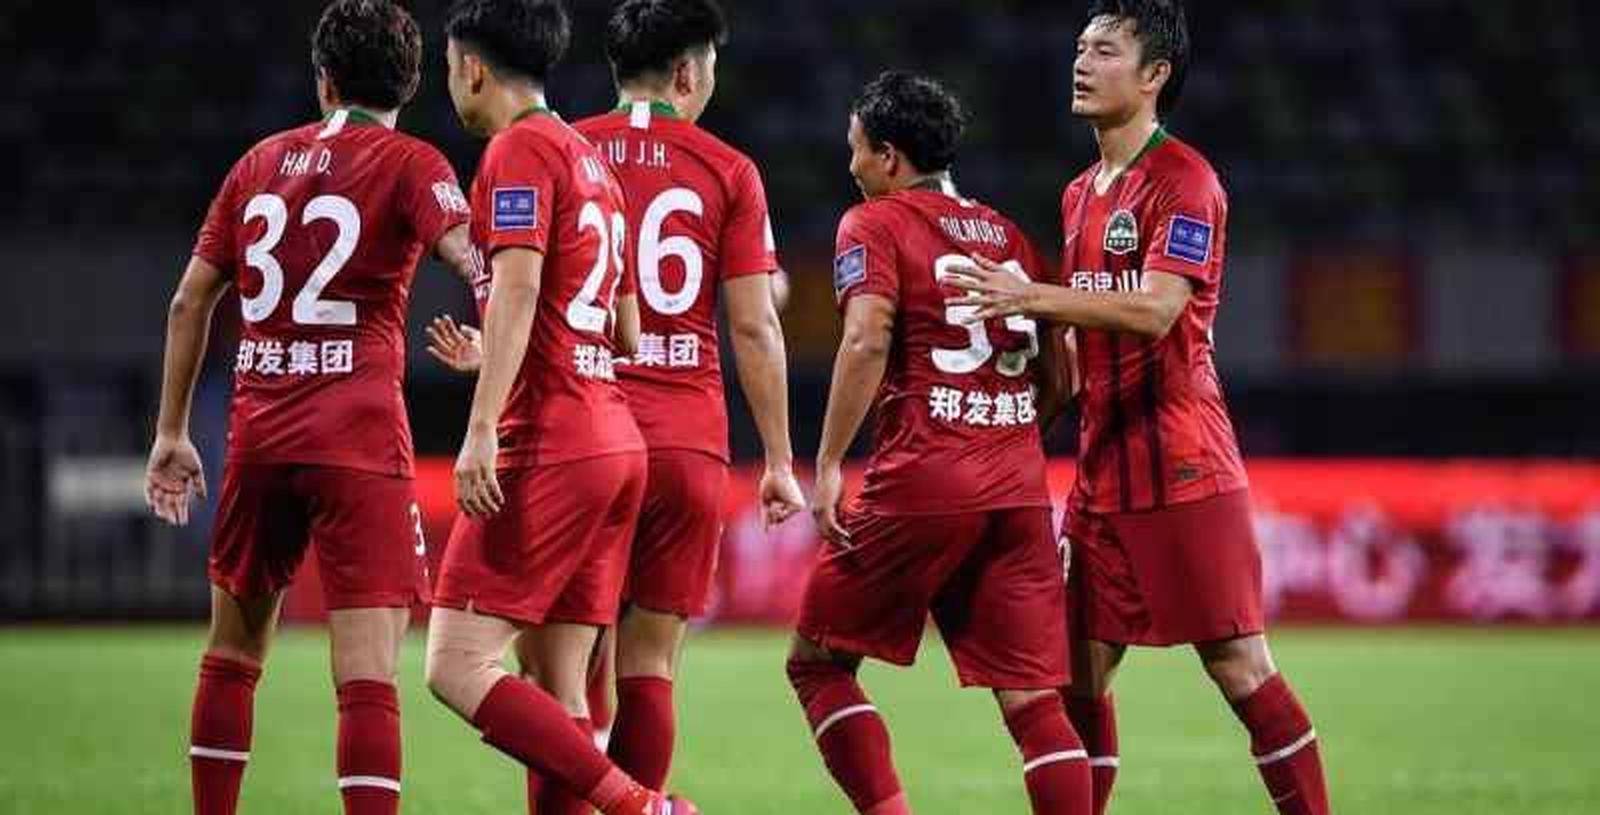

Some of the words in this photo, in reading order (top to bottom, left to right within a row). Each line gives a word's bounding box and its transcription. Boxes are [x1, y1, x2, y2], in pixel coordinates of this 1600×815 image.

[635, 140, 671, 168] J.H.
[240, 192, 361, 325] 32
[637, 187, 704, 315] 6
[236, 339, 353, 374] 郑发集团
[929, 385, 1037, 427] 郑发集团
